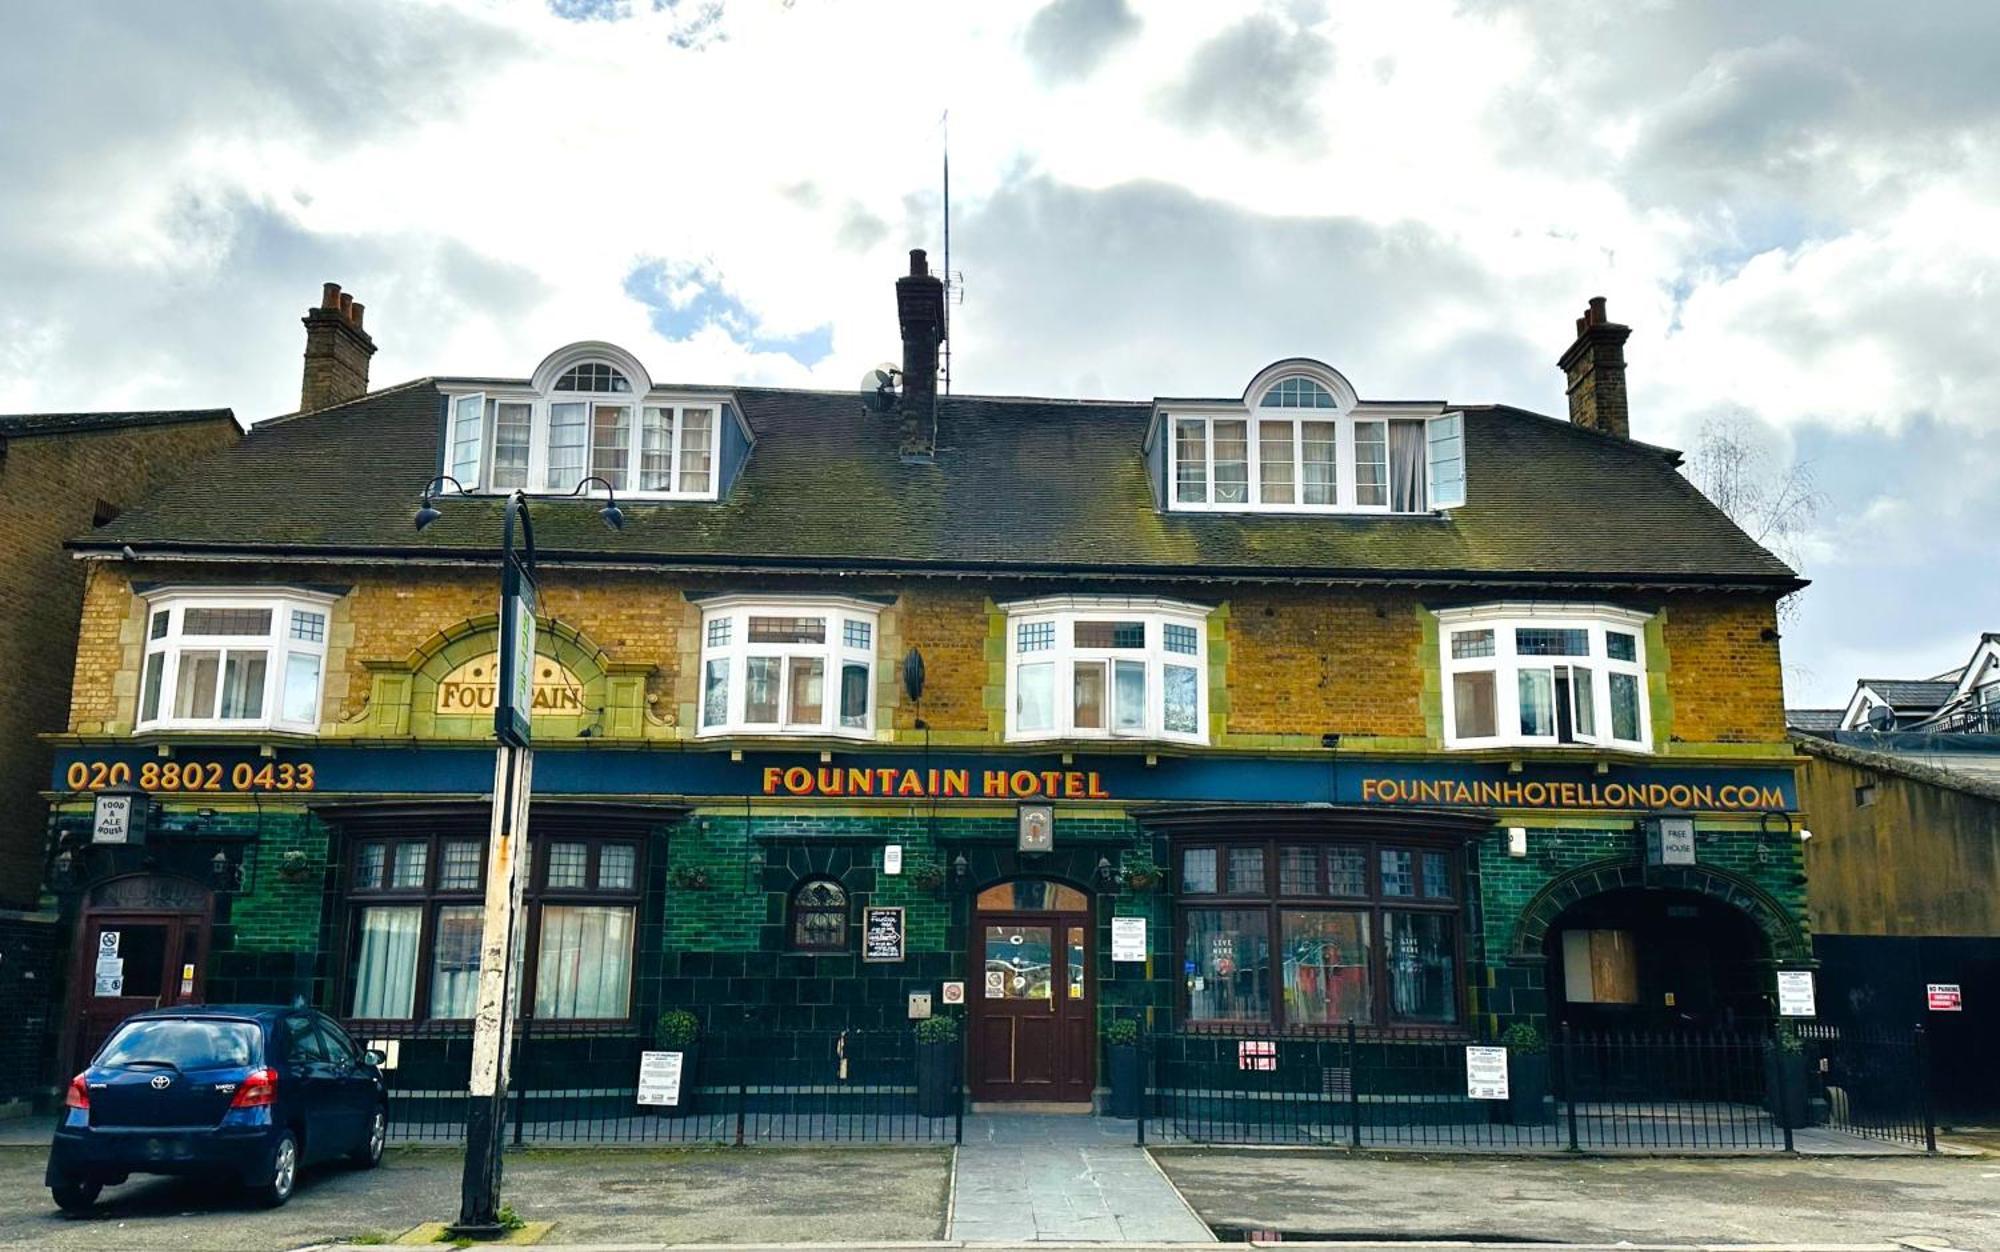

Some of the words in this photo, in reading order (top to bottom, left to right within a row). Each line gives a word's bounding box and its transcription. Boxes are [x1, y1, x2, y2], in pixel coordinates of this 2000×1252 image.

[441, 682, 579, 709] FOUAIN
[67, 762, 131, 791] 020
[140, 762, 223, 791] 8802
[232, 762, 314, 791] 0433
[763, 766, 969, 796] FOUNTAIN
[983, 769, 1109, 799] HOTEL
[1361, 778, 1784, 809] FOUNTAINHOTELLONDON.COM
[97, 826, 123, 835] HOUSE
[1668, 830, 1687, 838] FREE
[1666, 844, 1690, 853] HOUSE
